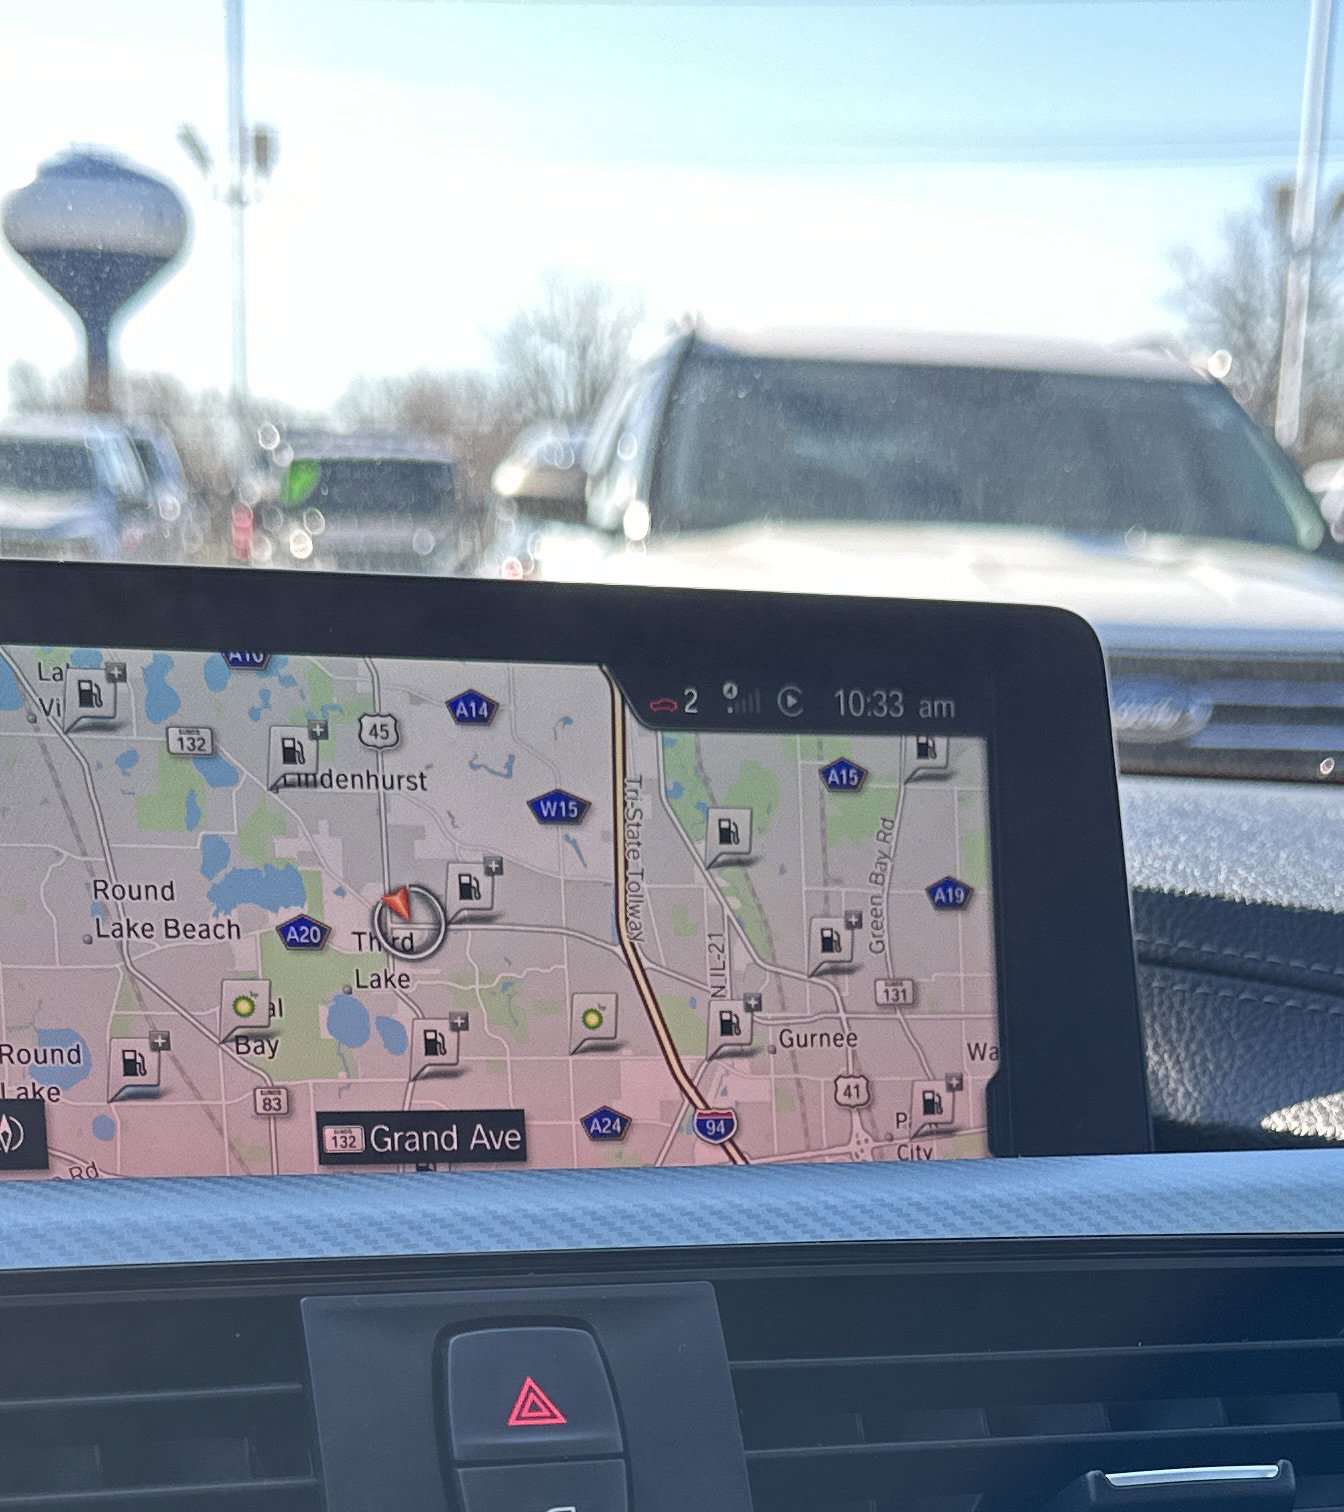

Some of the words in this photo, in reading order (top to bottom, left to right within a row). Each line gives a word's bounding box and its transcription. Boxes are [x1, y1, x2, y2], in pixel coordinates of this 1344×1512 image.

[456, 701, 488, 719] A14
[684, 688, 698, 714] 2
[834, 690, 904, 718] 10:33
[918, 698, 956, 719] am
[369, 723, 390, 740] 45
[177, 737, 206, 752] 132
[828, 768, 858, 786] A15
[540, 801, 578, 818] W15
[626, 774, 644, 860] Tri-State
[876, 817, 895, 844] Rd
[869, 850, 892, 886] Bay
[93, 879, 175, 901] Round
[935, 887, 965, 904] A19
[626, 867, 645, 943] Tollway
[96, 918, 155, 939] Lake
[164, 918, 241, 940] Beach
[869, 895, 886, 954] Green
[286, 926, 321, 944] A20
[351, 931, 414, 952] Thrd
[708, 932, 726, 978] IL-21
[355, 968, 411, 989] Lake
[710, 985, 727, 998] N
[884, 988, 907, 1002] 131
[235, 1035, 279, 1059] Bay
[778, 1028, 858, 1048] Gurnee
[843, 1084, 861, 1099] 41
[262, 1097, 282, 1111] 83
[590, 1117, 621, 1134] A24
[706, 1120, 726, 1135] 94
[332, 1135, 357, 1149] 132
[370, 1124, 458, 1152] Grand
[470, 1123, 521, 1151] Ave
